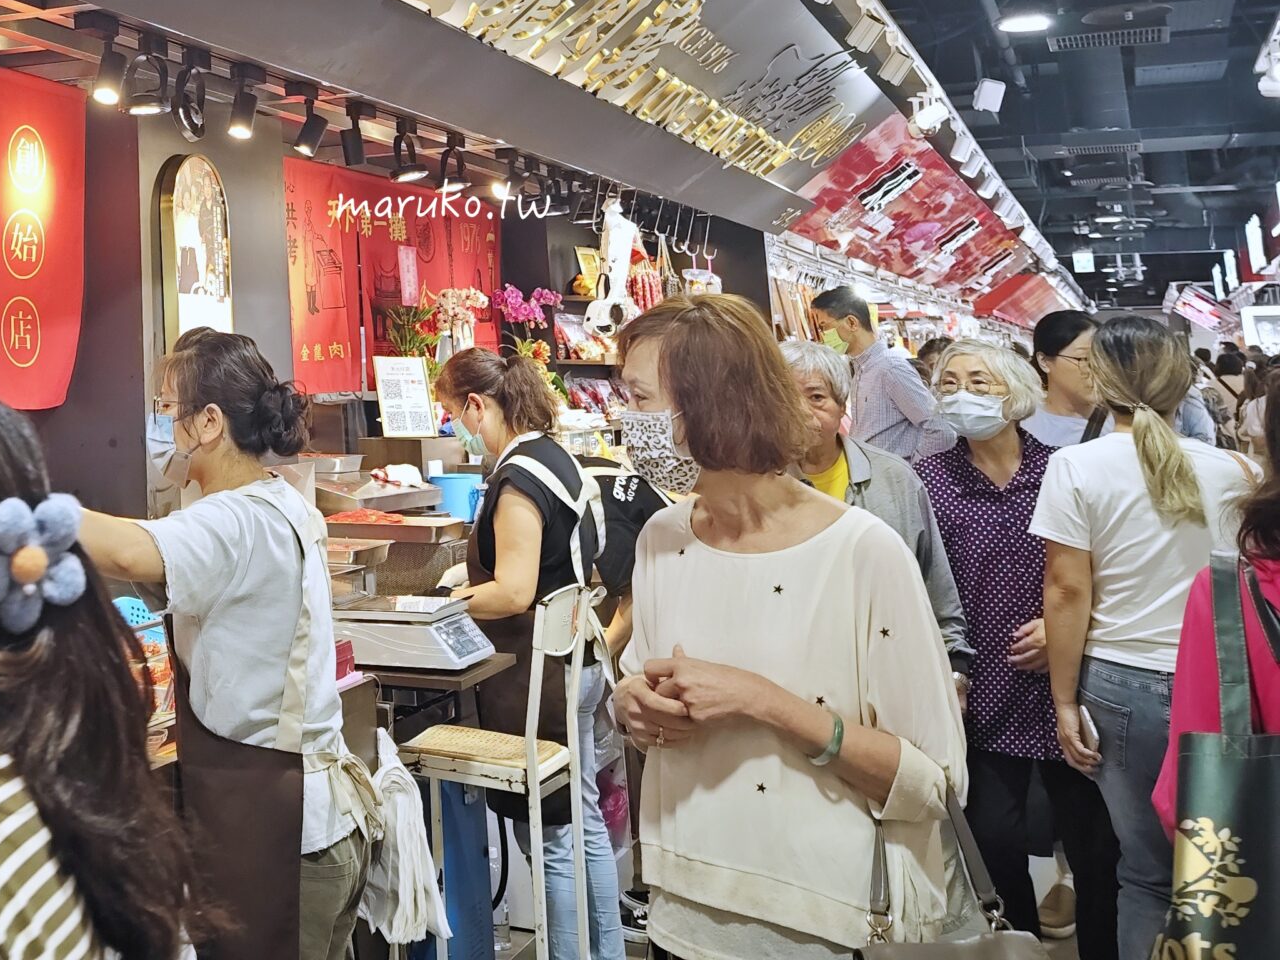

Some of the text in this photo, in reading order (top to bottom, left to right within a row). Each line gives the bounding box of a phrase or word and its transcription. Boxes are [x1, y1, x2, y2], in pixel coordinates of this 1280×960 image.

[9, 137, 40, 351] 創始店
[301, 341, 351, 361] 金龍肉
